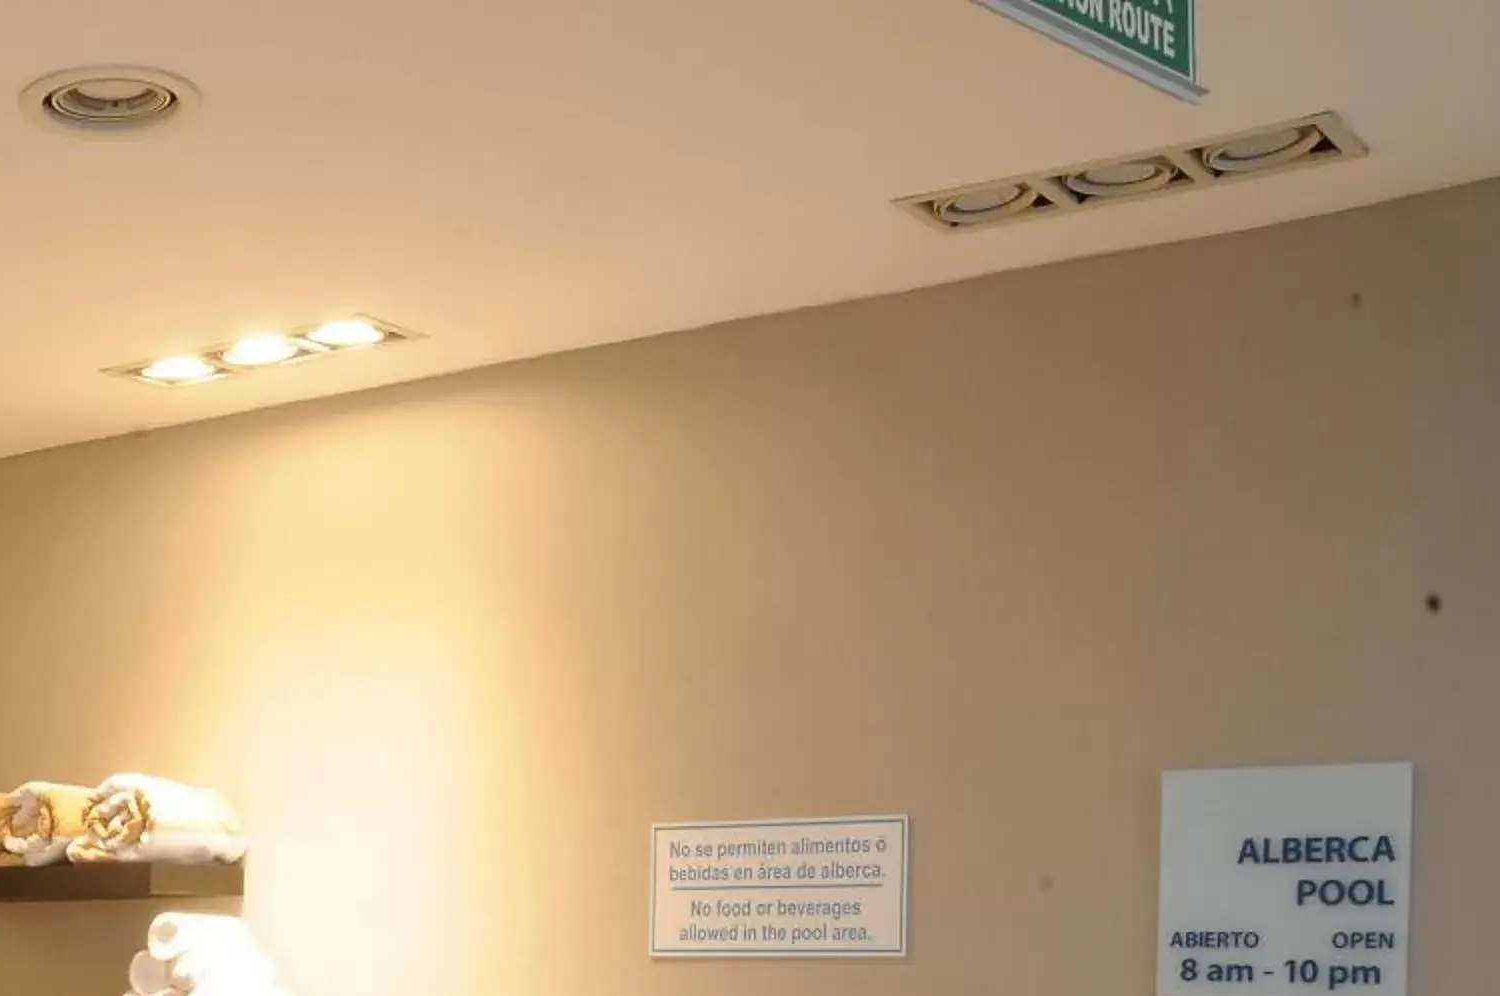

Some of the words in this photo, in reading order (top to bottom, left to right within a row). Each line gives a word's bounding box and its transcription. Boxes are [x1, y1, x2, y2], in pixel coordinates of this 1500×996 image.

[1109, 0, 1176, 59] ROUTE
[669, 840, 691, 858] No
[695, 844, 713, 857] se
[717, 839, 787, 861] permiten
[791, 837, 871, 855] alimentos
[1237, 835, 1396, 864] ALBERCA
[669, 863, 730, 881] bebidas
[734, 866, 753, 880] en
[757, 862, 792, 880] área
[797, 862, 816, 880] de
[821, 861, 887, 879] alberca.
[1296, 879, 1395, 906] POOL
[690, 900, 712, 917] No
[716, 899, 751, 916] food
[756, 902, 773, 916] or
[777, 898, 862, 920] beverages
[680, 924, 738, 941] allowed
[743, 924, 757, 940] in
[762, 924, 787, 940] the
[791, 923, 828, 944] pool
[832, 925, 872, 941] area.
[1169, 931, 1260, 949] ABIERTO
[1331, 931, 1395, 949] OPEN
[1179, 958, 1198, 982] 8
[1206, 963, 1254, 982] am
[1284, 959, 1319, 983] 10
[1328, 964, 1381, 990] pm
